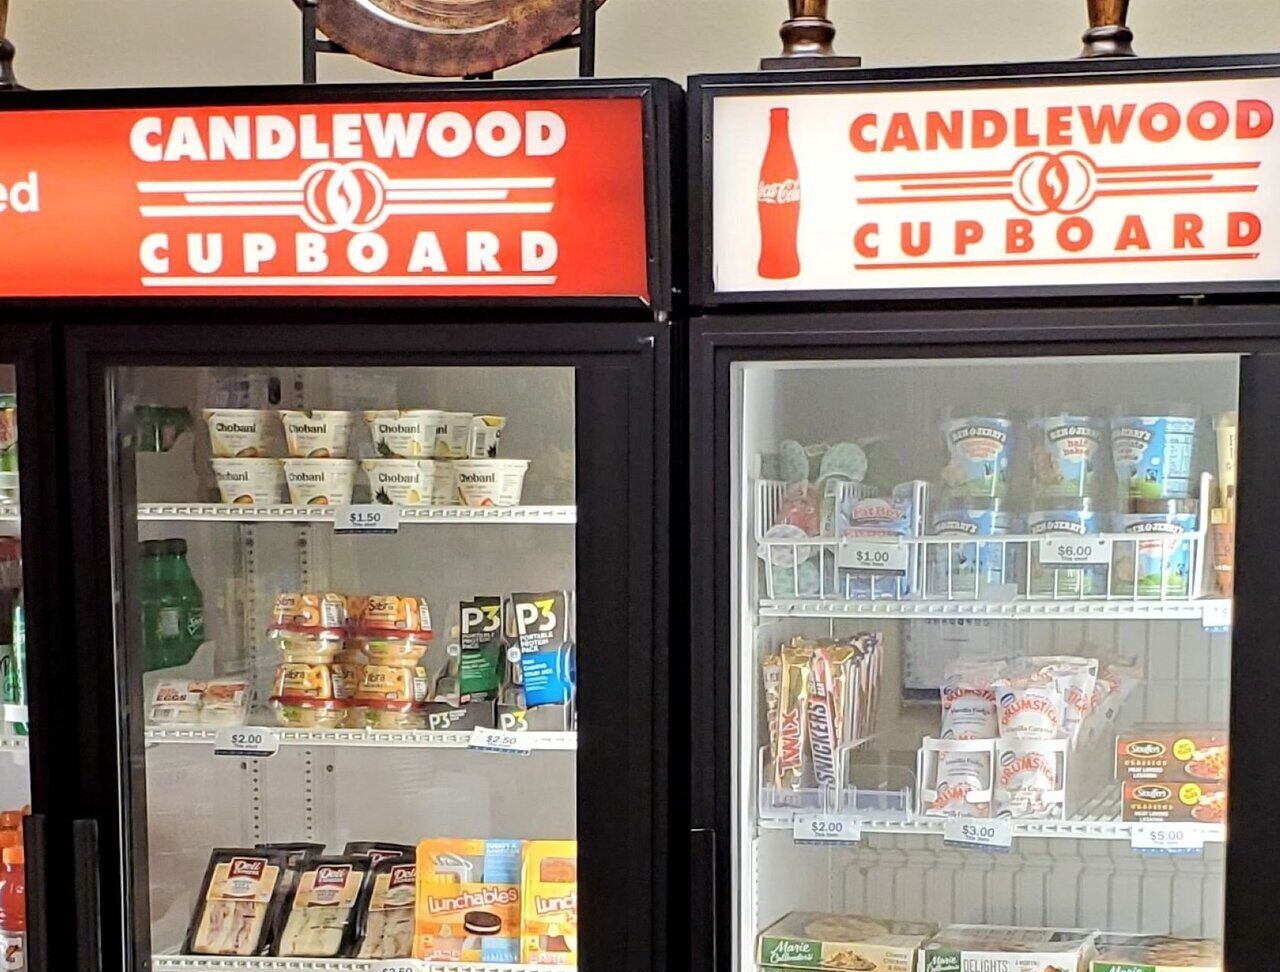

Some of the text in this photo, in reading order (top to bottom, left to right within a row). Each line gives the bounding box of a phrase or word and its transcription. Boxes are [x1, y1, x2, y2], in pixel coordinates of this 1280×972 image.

[849, 99, 1275, 152] CANDLEWOOD
[129, 110, 567, 162] CANDLEWOOD
[757, 178, 801, 204] Coca-Cola
[853, 211, 1262, 257] CUPBOARD
[139, 231, 558, 274] CUPBOARD
[216, 422, 256, 433] Chobani
[289, 423, 327, 434] Chobani
[379, 423, 420, 434] Chobani
[289, 472, 325, 482] Chobani
[378, 472, 420, 483] Chobani
[458, 472, 496, 484] Chobani
[349, 511, 381, 523] $1.50
[856, 551, 889, 563] $1.00
[1058, 546, 1092, 557] $6.00
[462, 606, 500, 633] P3
[515, 598, 557, 634] P3
[1001, 699, 1058, 728] DRUMSTICK
[428, 711, 451, 731] P3
[500, 710, 529, 732] P3
[231, 734, 263, 745] $2.00
[486, 735, 517, 746] $2.50
[780, 708, 802, 777] TWIX
[808, 701, 837, 790] SNICKERS
[1000, 755, 1055, 786] DRUMSTICK
[812, 822, 843, 832] $2.00
[962, 824, 995, 838] $3.00
[1150, 831, 1184, 841] $5.00
[428, 886, 519, 915] Lunchables
[773, 940, 810, 955] Marie
[929, 953, 958, 966] Marie
